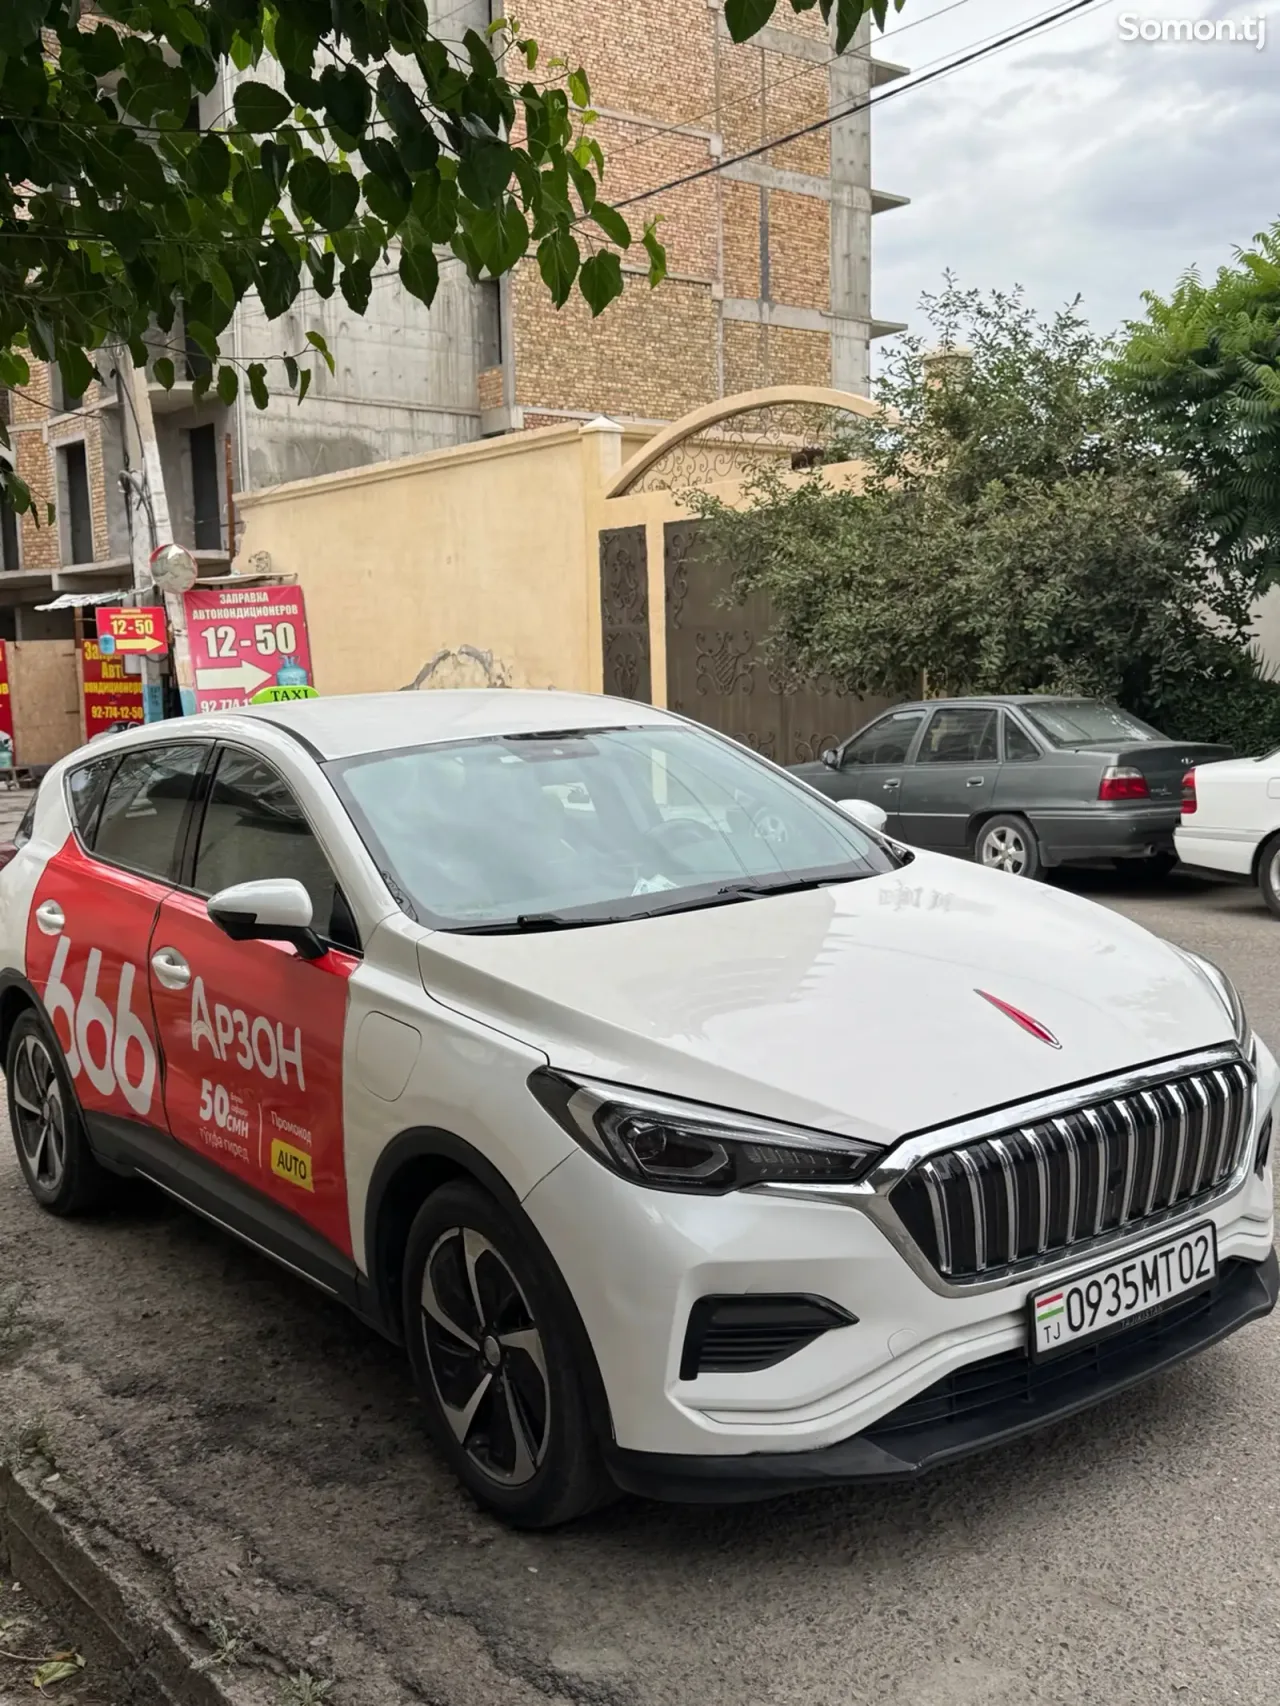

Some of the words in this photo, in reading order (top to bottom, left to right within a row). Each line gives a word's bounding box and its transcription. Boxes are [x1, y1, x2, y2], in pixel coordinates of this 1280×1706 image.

[219, 591, 269, 605] ЗАПРАВКА
[192, 604, 298, 620] АВТОКОНДИЦИОНЕРОВ
[110, 619, 154, 636] 12-50
[270, 689, 309, 702] TAXI
[91, 705, 144, 719] 92-774-12-50
[43, 935, 157, 1116] 666
[199, 1077, 230, 1128] 50
[270, 1110, 312, 1147] Промокод
[277, 1150, 307, 1180] AUTO
[1043, 1321, 1062, 1344] TJ
[1066, 1234, 1210, 1333] 0935MT02
